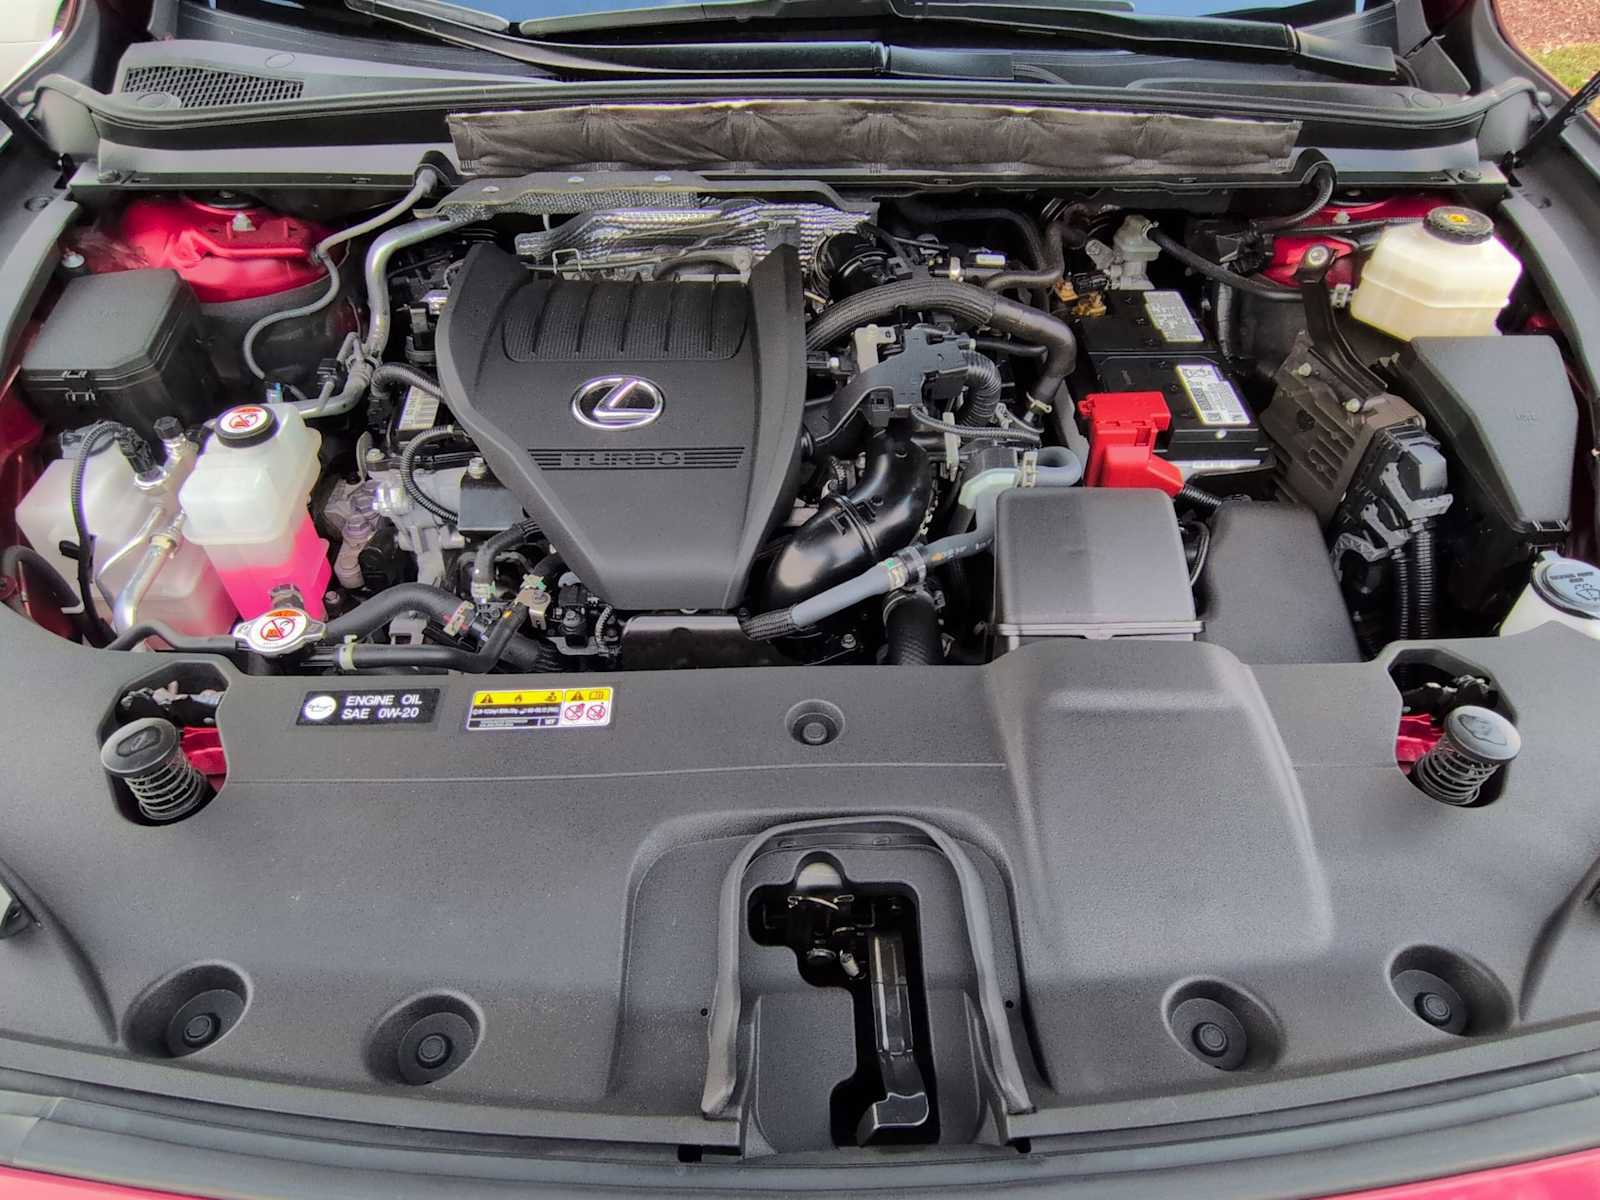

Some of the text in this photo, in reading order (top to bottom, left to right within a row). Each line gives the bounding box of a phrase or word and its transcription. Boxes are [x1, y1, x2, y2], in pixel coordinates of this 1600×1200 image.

[565, 452, 680, 465] TURBO
[345, 694, 422, 706] ENGINE OIL
[341, 707, 419, 719] SAE 0W-20
